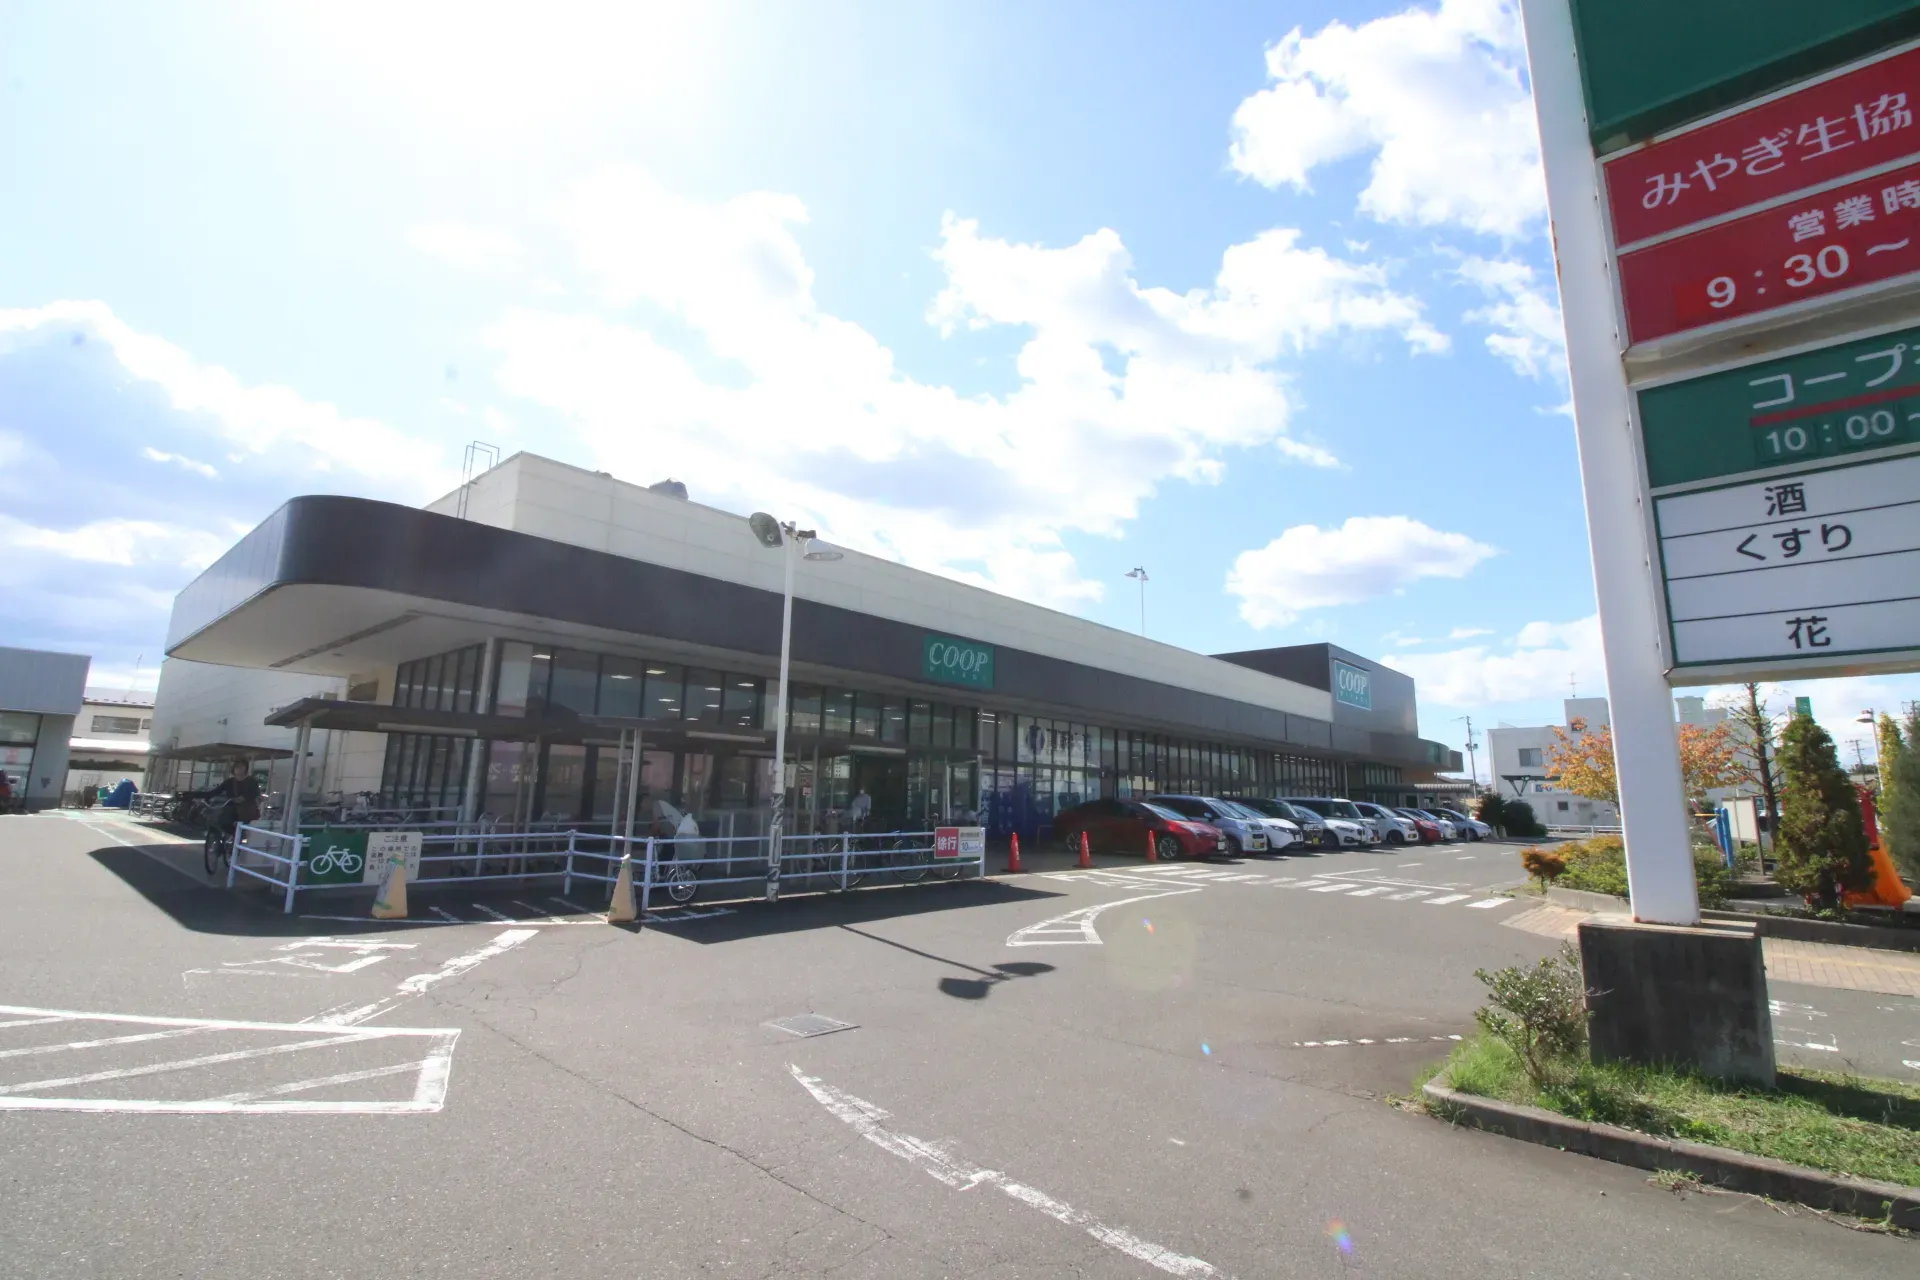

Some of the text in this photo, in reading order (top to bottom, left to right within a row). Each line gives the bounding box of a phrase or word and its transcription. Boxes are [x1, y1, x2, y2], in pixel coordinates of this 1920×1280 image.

[1642, 93, 1912, 210] みやぎ生協
[1749, 343, 1920, 409] コープ
[1764, 482, 1807, 516] 酒
[1736, 523, 1852, 561] くすり
[1786, 615, 1831, 649] 花
[929, 642, 989, 672] COOP
[1339, 669, 1367, 695] COOP
[937, 836, 957, 851] 徐行
